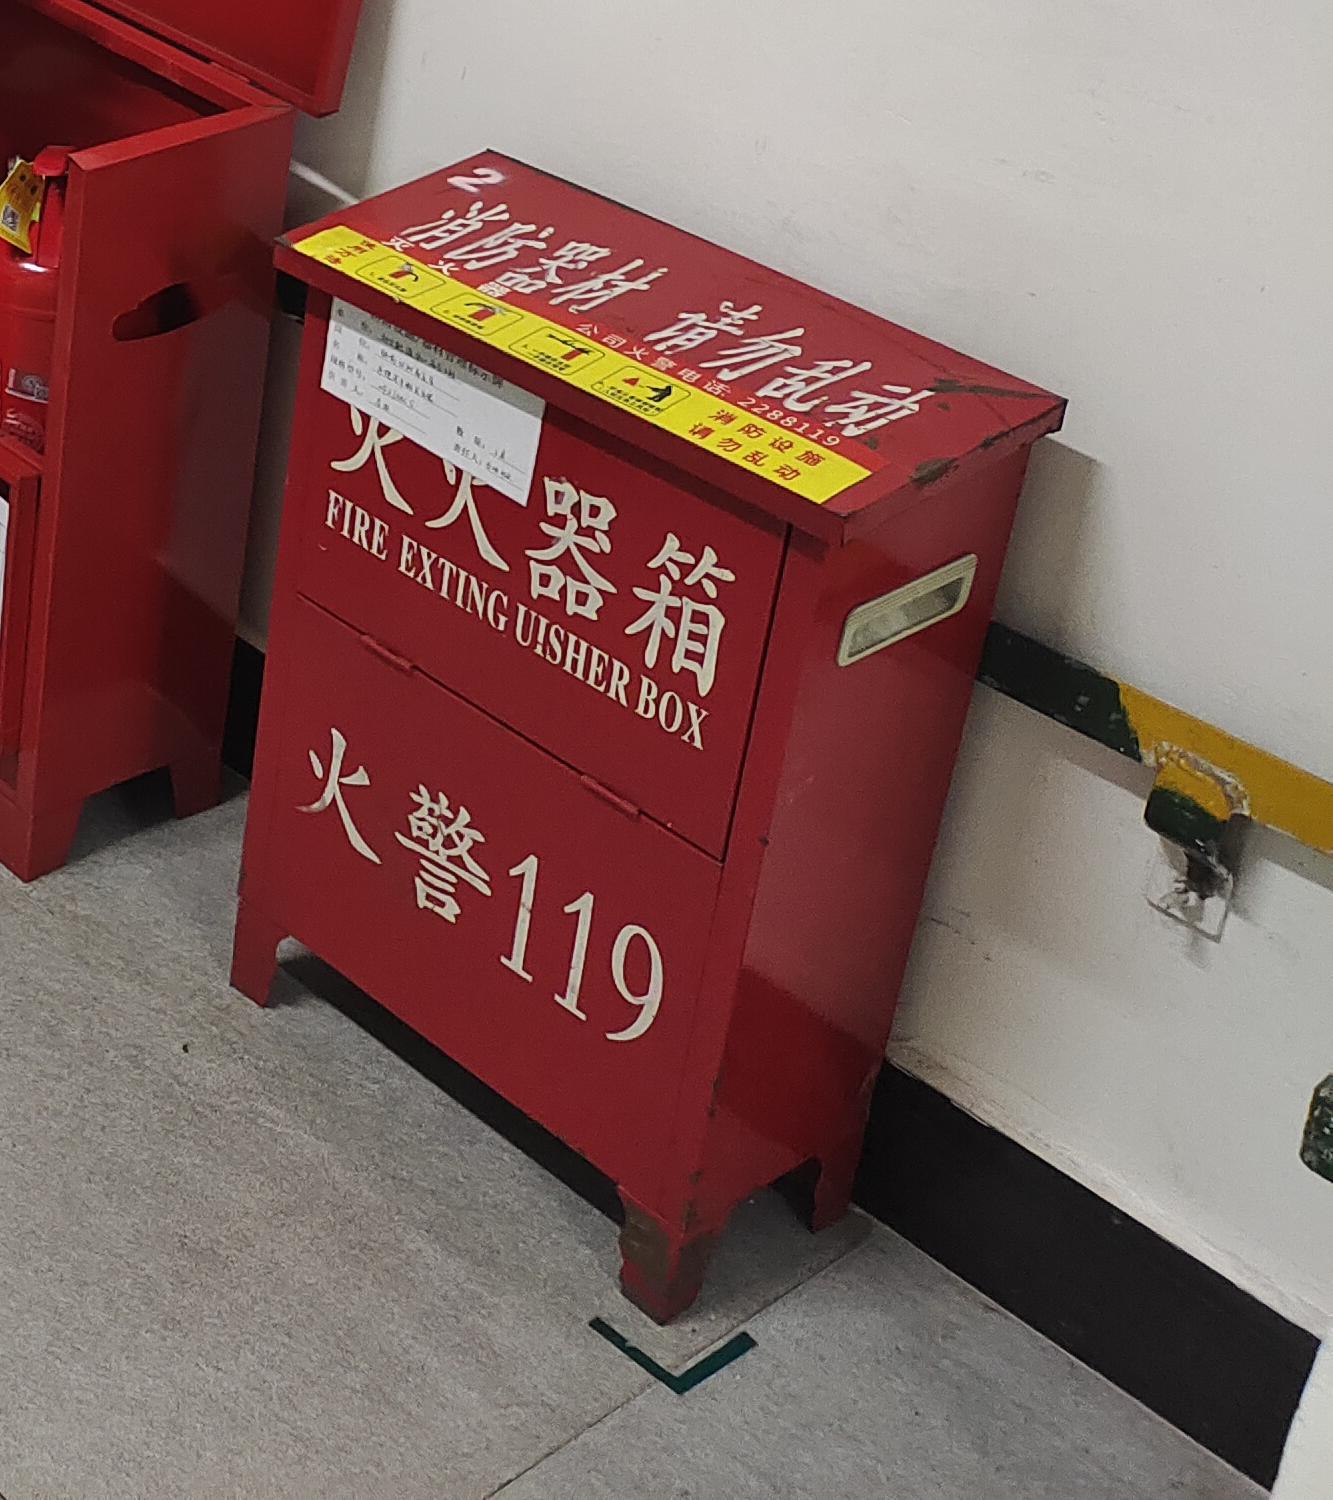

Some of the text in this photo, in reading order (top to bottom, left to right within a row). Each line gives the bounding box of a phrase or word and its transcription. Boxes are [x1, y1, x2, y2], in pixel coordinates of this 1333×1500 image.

[446, 167, 506, 194] 2
[381, 235, 512, 298] 灭火器
[398, 201, 668, 314] 消防器材
[643, 301, 935, 437] 请勿乱动
[708, 408, 826, 467] 消防设施
[736, 396, 841, 447] 2288119
[688, 422, 801, 481] 请勿乱动
[325, 489, 389, 561] FIRE
[635, 674, 711, 751] BOX
